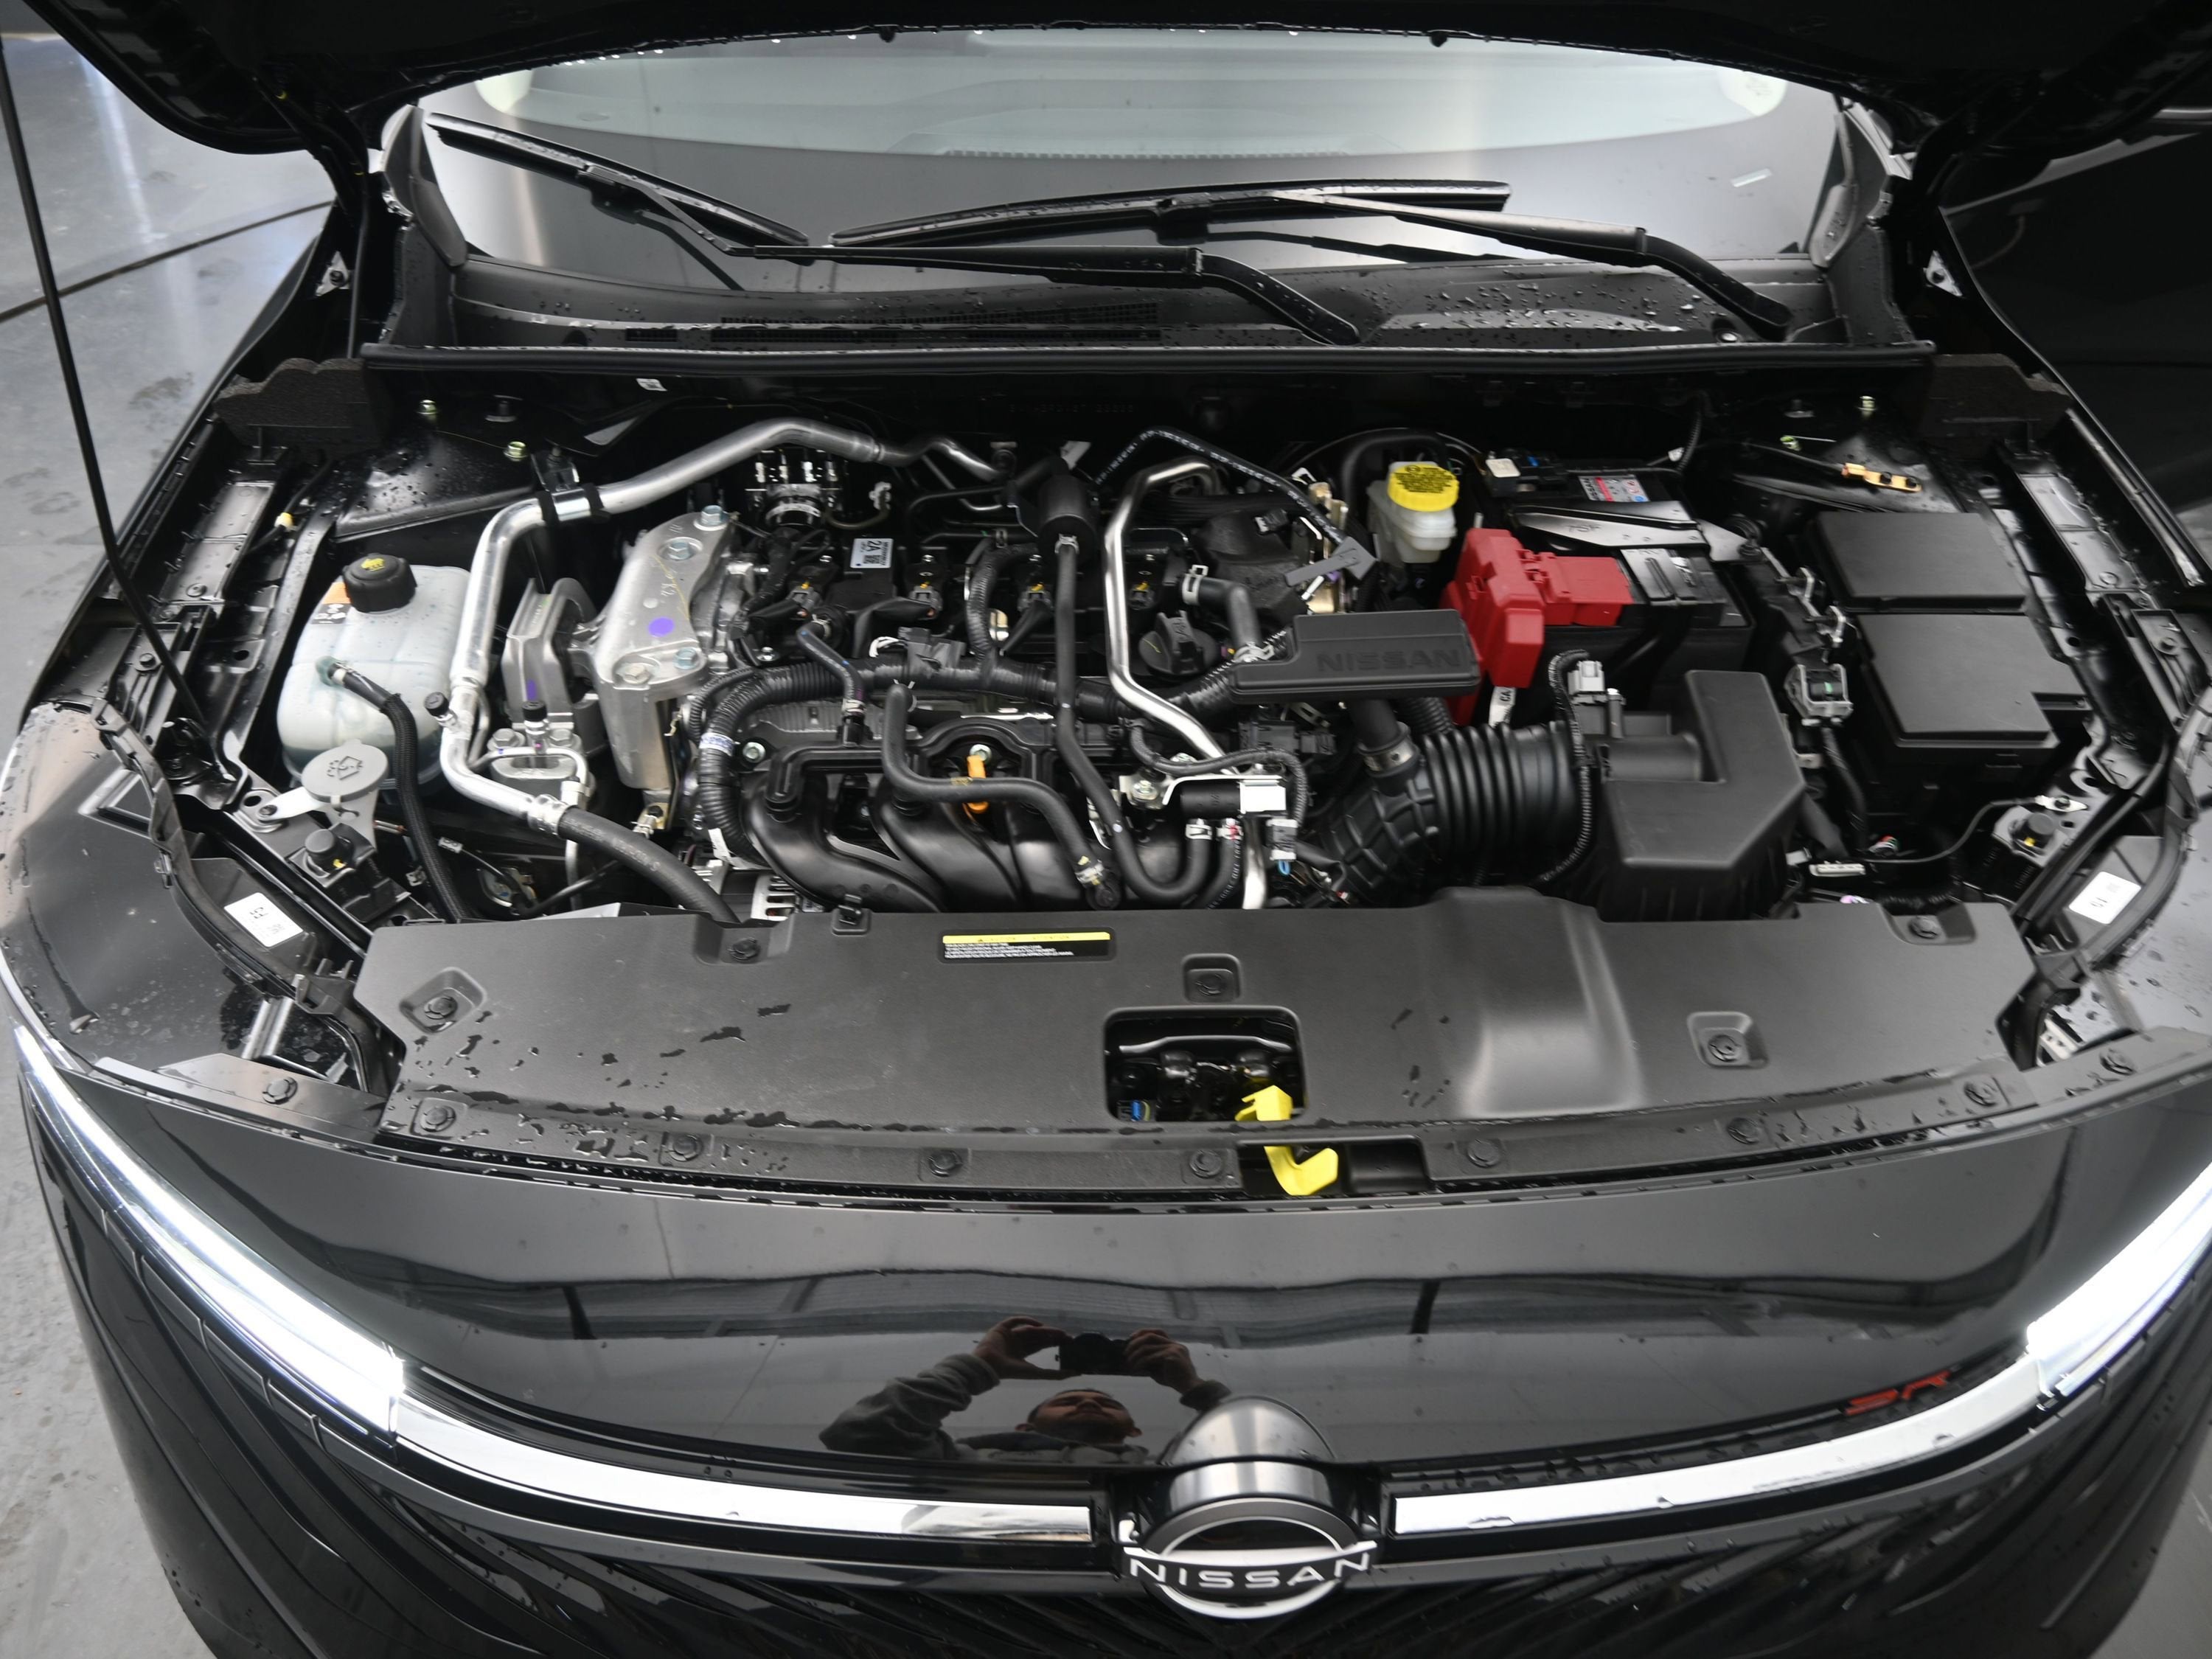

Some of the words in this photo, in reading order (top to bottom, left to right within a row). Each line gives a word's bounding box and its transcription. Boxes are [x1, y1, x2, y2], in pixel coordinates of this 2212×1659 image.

[867, 540, 882, 552] 2A
[1317, 650, 1461, 672] NISSAN
[1129, 1551, 1370, 1590] NISSAN
